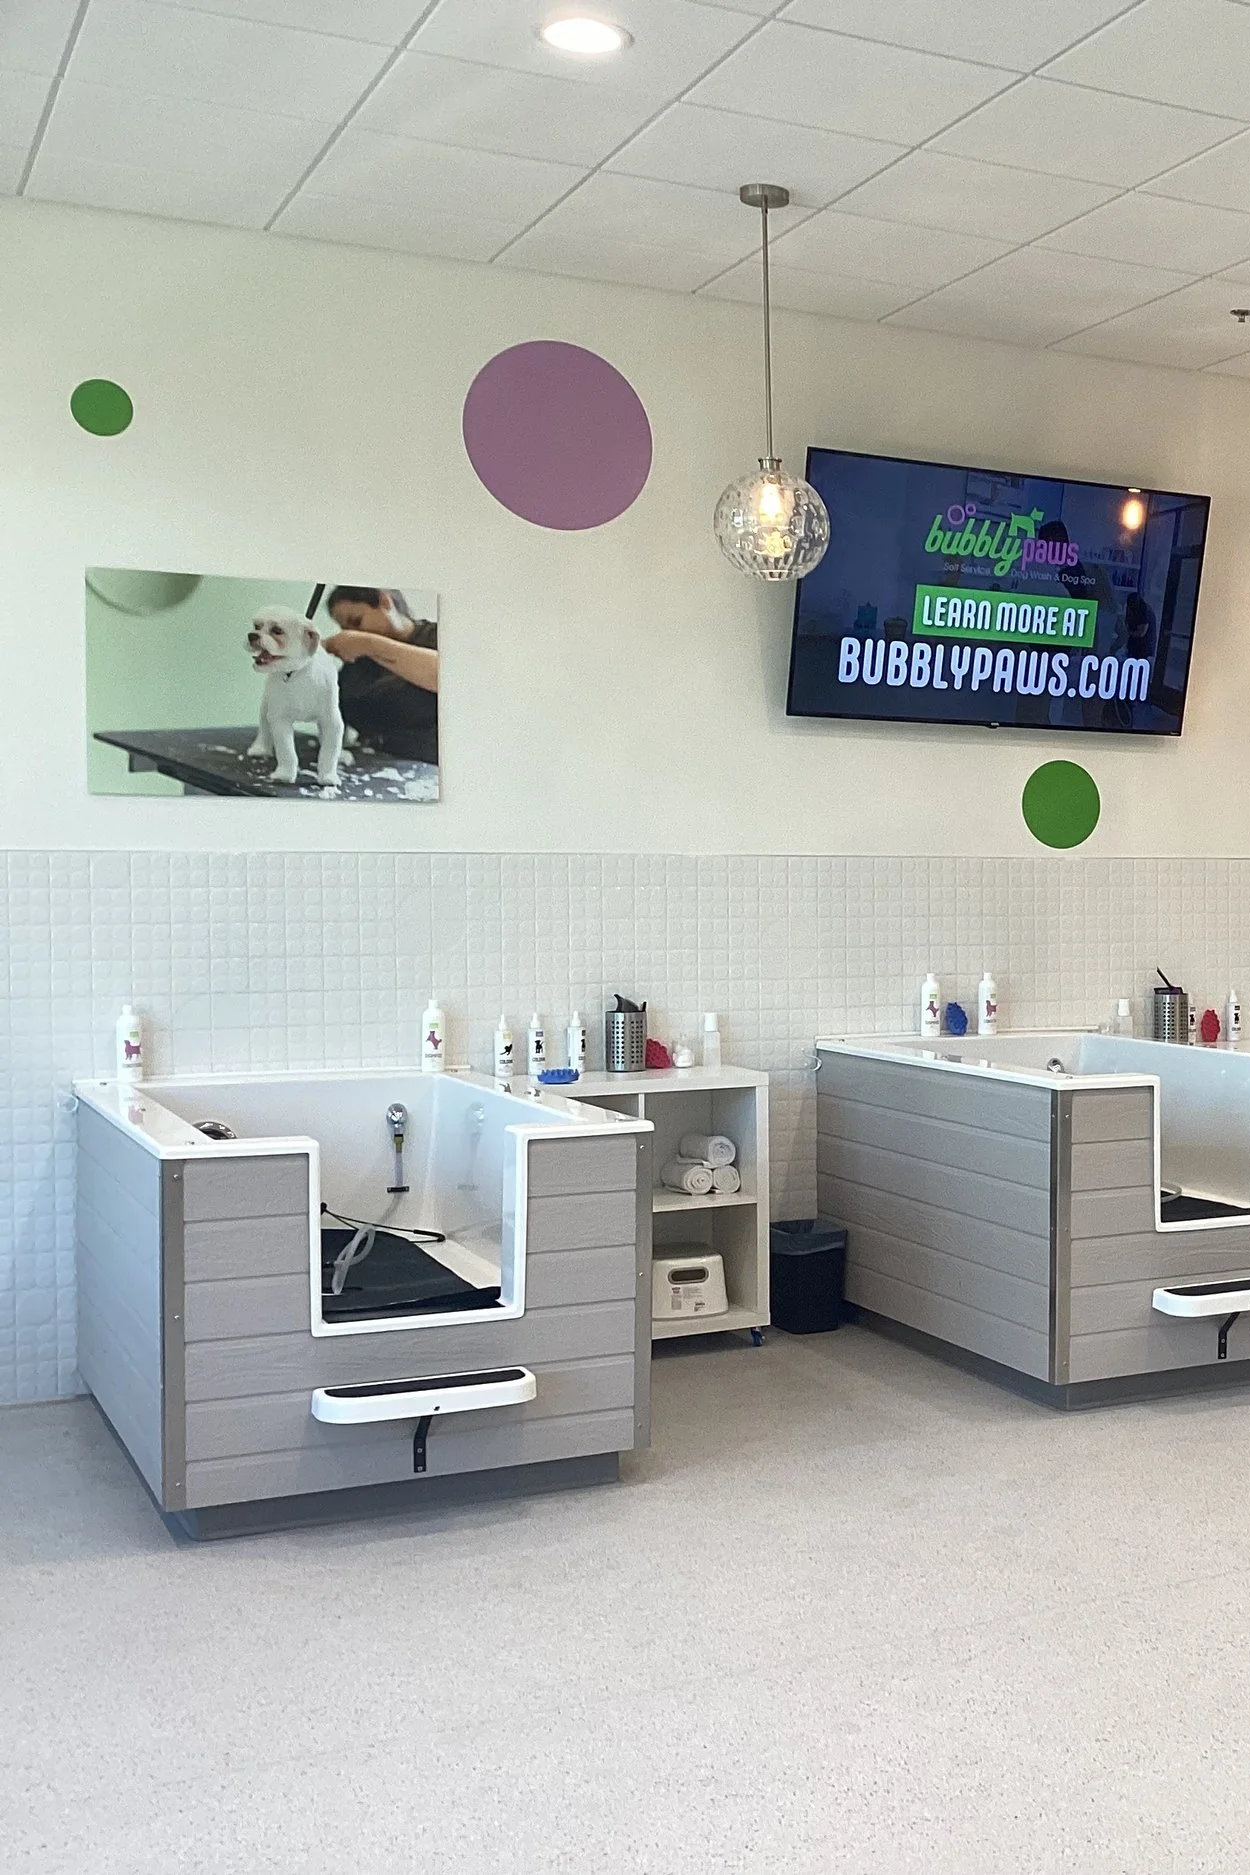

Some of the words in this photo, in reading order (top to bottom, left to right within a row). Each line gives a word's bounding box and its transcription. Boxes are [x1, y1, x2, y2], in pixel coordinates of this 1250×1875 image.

[923, 513, 1022, 577] bubbly
[1020, 538, 1080, 571] paws
[943, 563, 961, 572] Self
[961, 564, 991, 576] Service
[1010, 568, 1028, 580] Dog
[1030, 570, 1051, 581] Wash
[1053, 574, 1060, 582] &
[1061, 573, 1079, 585] Dog
[1080, 575, 1096, 586] Spa
[922, 595, 992, 630] LEARN
[995, 601, 1059, 636] MORE
[1062, 608, 1089, 638] AT
[837, 637, 1151, 701] BUBBLYPAWS.COM
